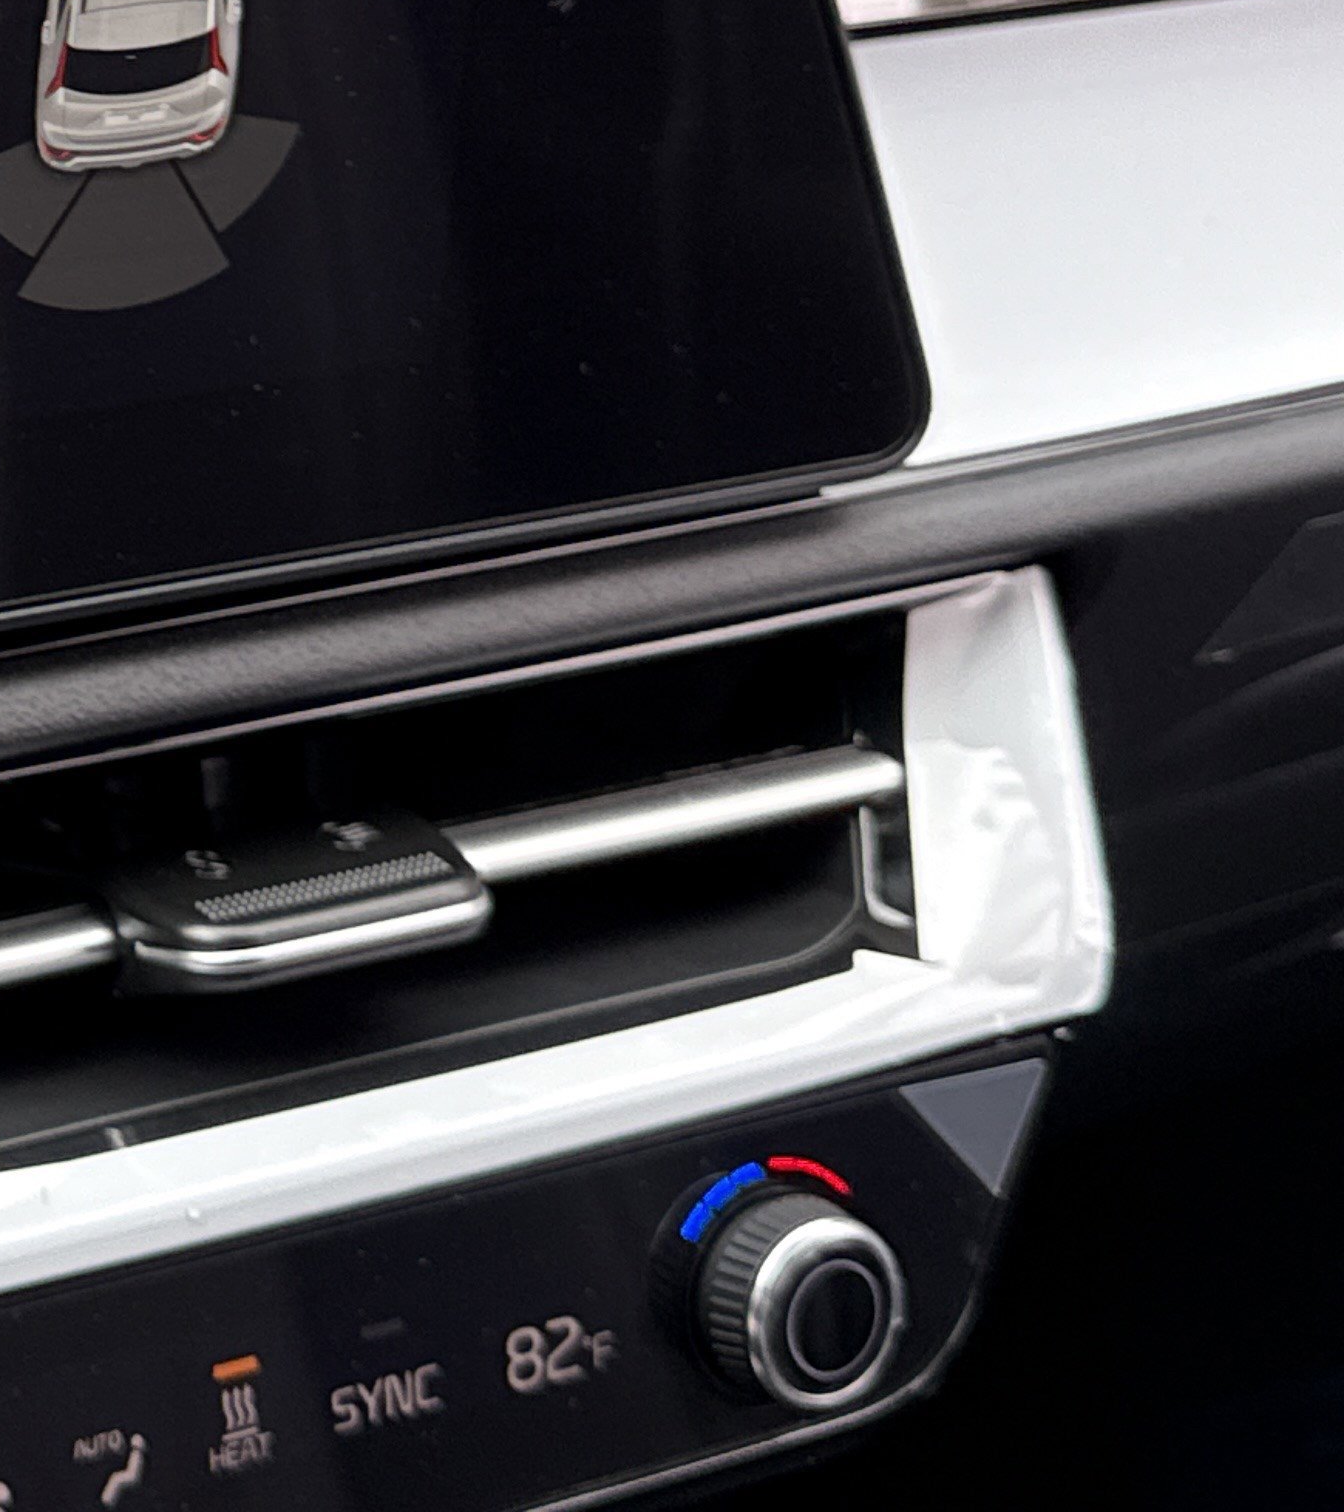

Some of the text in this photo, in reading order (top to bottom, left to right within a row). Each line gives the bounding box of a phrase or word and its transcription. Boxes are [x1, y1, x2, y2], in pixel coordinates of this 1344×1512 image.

[330, 1362, 445, 1435] SYNC
[72, 1429, 126, 1460] AUTO
[208, 1430, 276, 1473] HEAT
